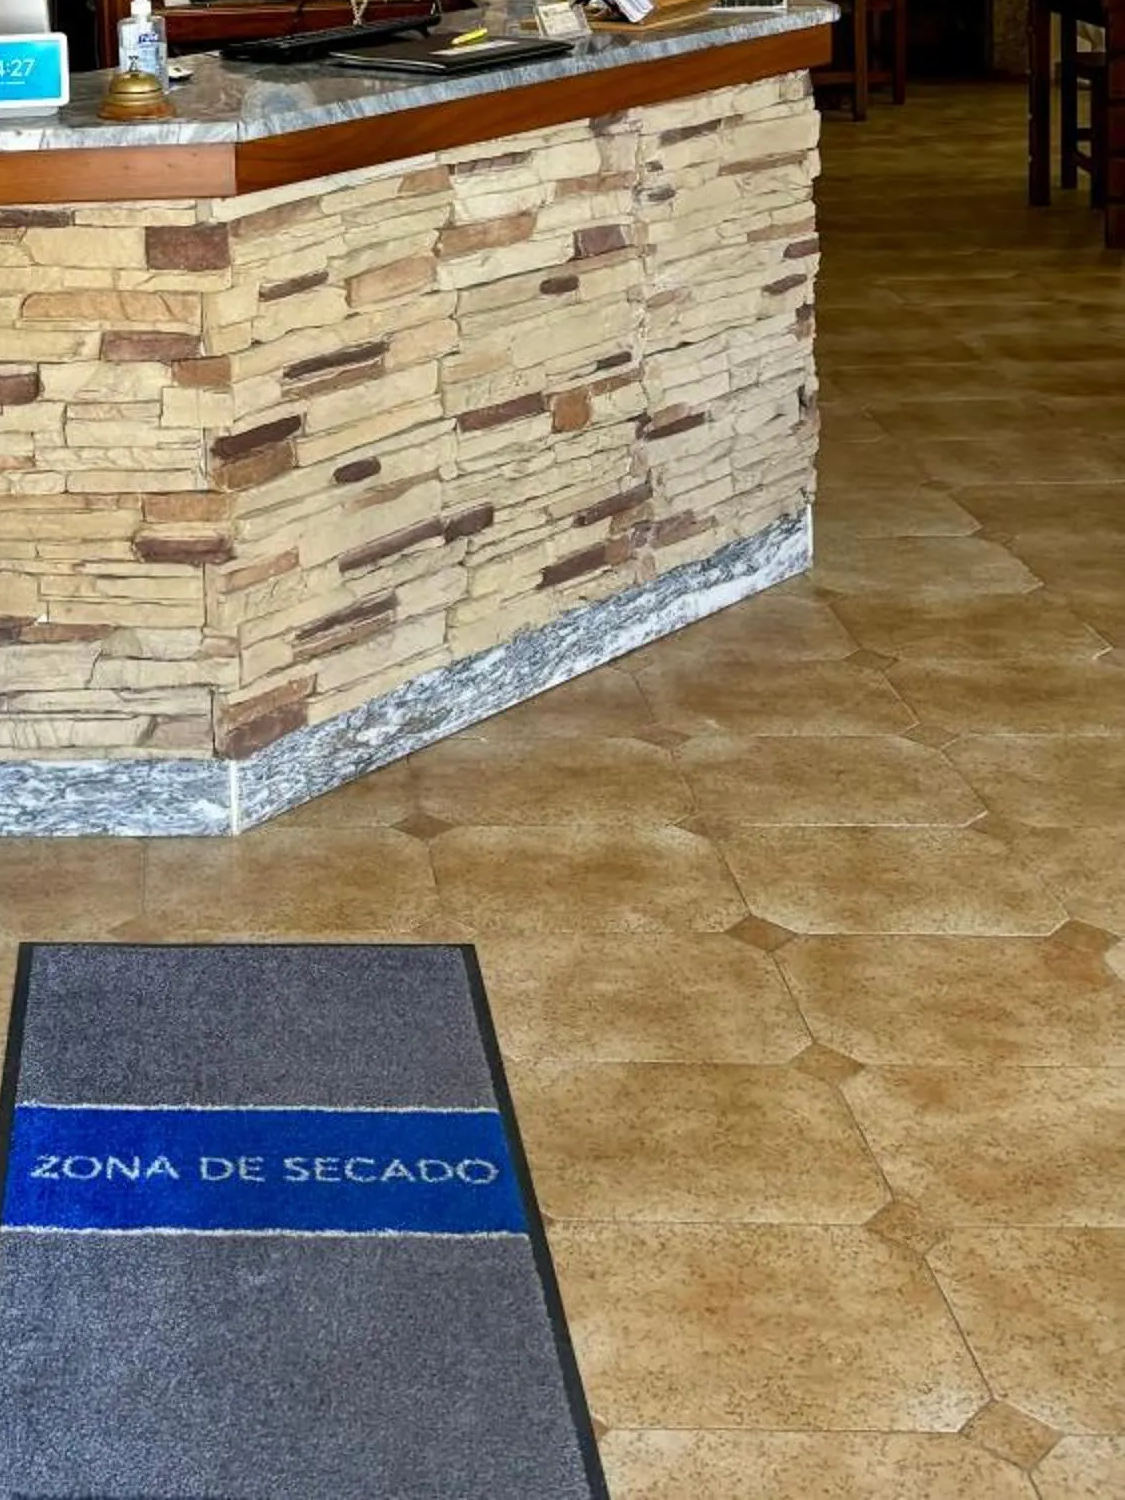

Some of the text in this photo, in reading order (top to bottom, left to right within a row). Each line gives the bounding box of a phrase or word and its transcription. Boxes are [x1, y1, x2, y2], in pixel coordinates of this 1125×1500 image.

[30, 1154, 500, 1185] ZONA DE SECADO
